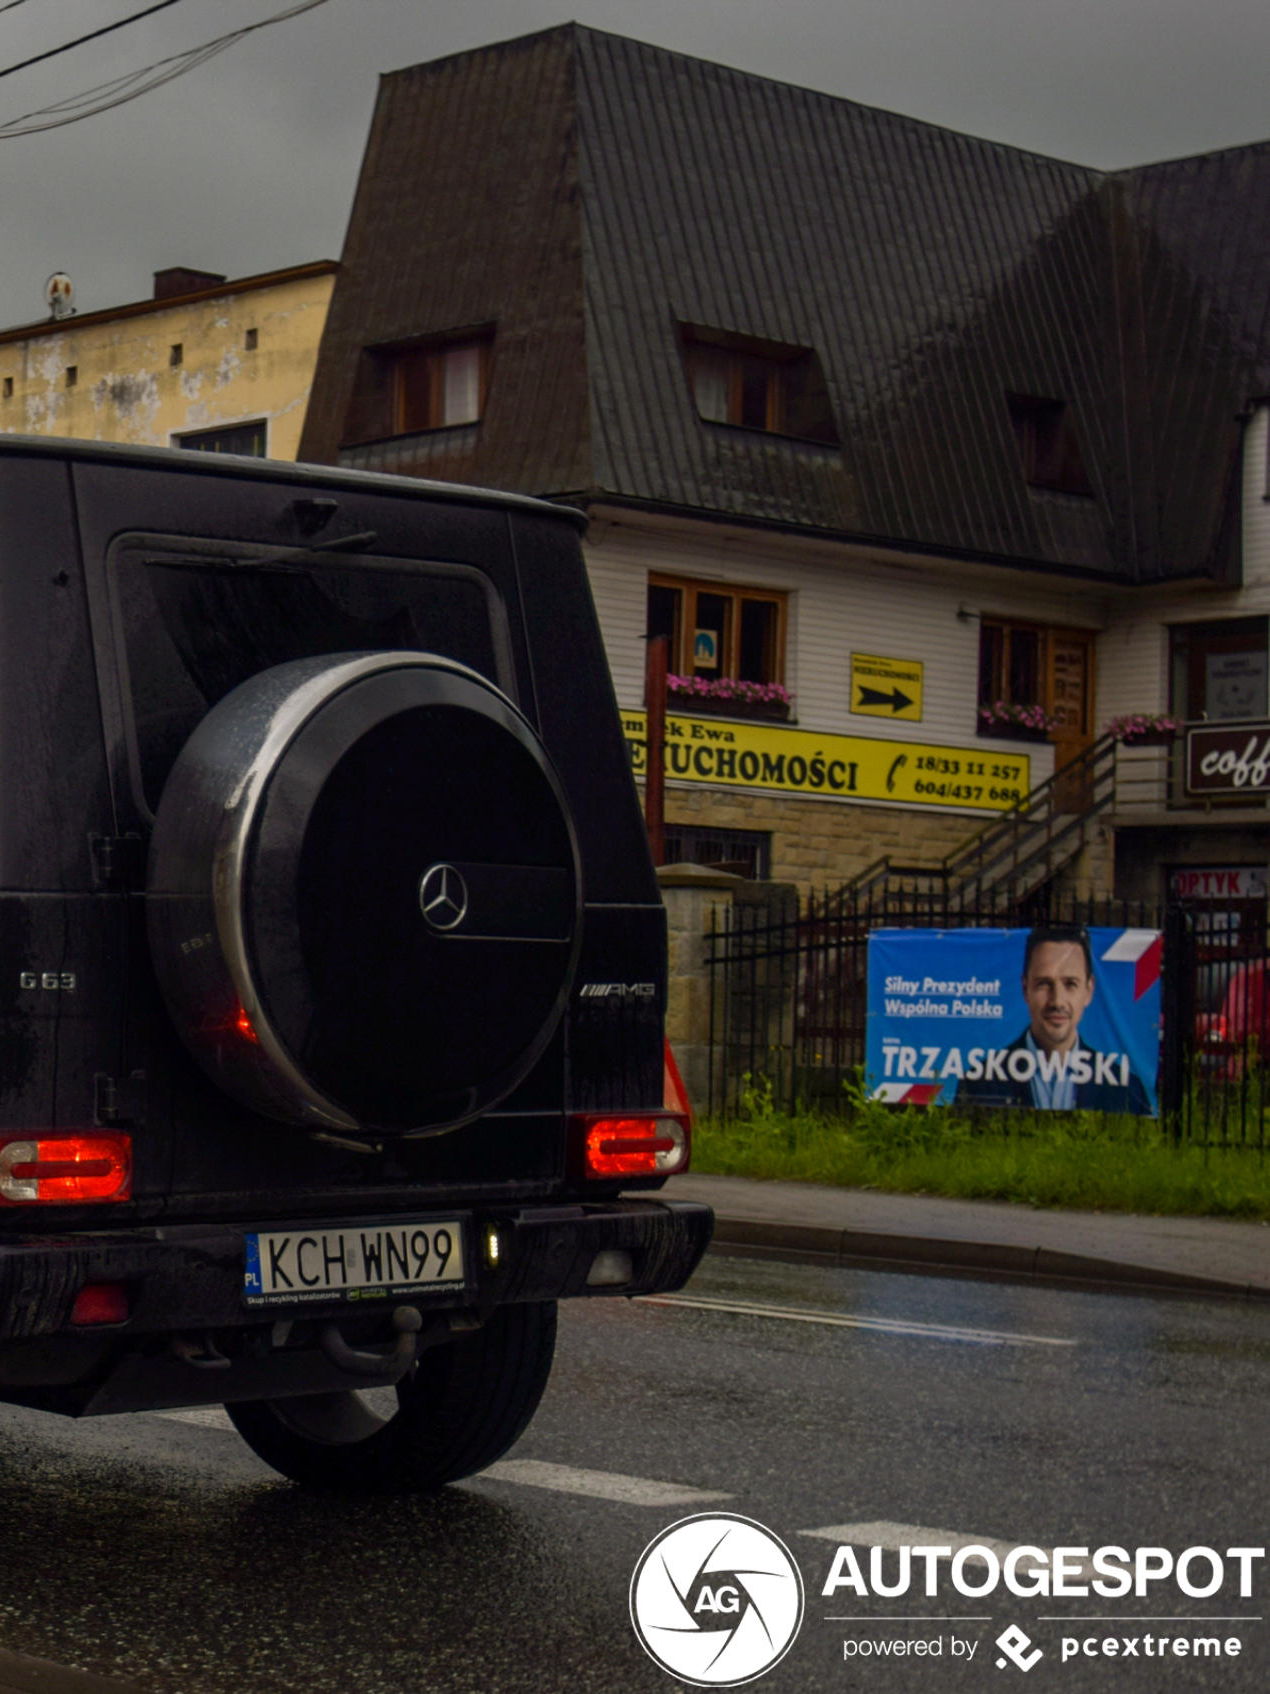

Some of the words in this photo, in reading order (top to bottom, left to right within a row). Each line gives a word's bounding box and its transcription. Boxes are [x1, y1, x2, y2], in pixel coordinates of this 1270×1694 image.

[690, 724, 735, 743] Ewa
[627, 739, 858, 791] EUCHOMOŚCI
[916, 756, 960, 775] 18/33
[966, 761, 985, 776] 11
[991, 765, 1021, 781] 257
[914, 778, 983, 800] 604/437
[989, 787, 1020, 803] 688
[602, 982, 655, 997] AMG
[884, 975, 920, 997] Silny
[922, 976, 1001, 997] Prezydent
[884, 998, 949, 1019] Wspólna
[952, 1000, 1003, 1018] Polska
[881, 1045, 1131, 1087] TRZASKOWSKI
[269, 1235, 347, 1289] KCH
[360, 1229, 452, 1282] WN99
[244, 1272, 260, 1287] PL
[247, 1296, 265, 1305] Skup
[269, 1293, 298, 1304] recykling
[299, 1291, 341, 1301] katalizatorów
